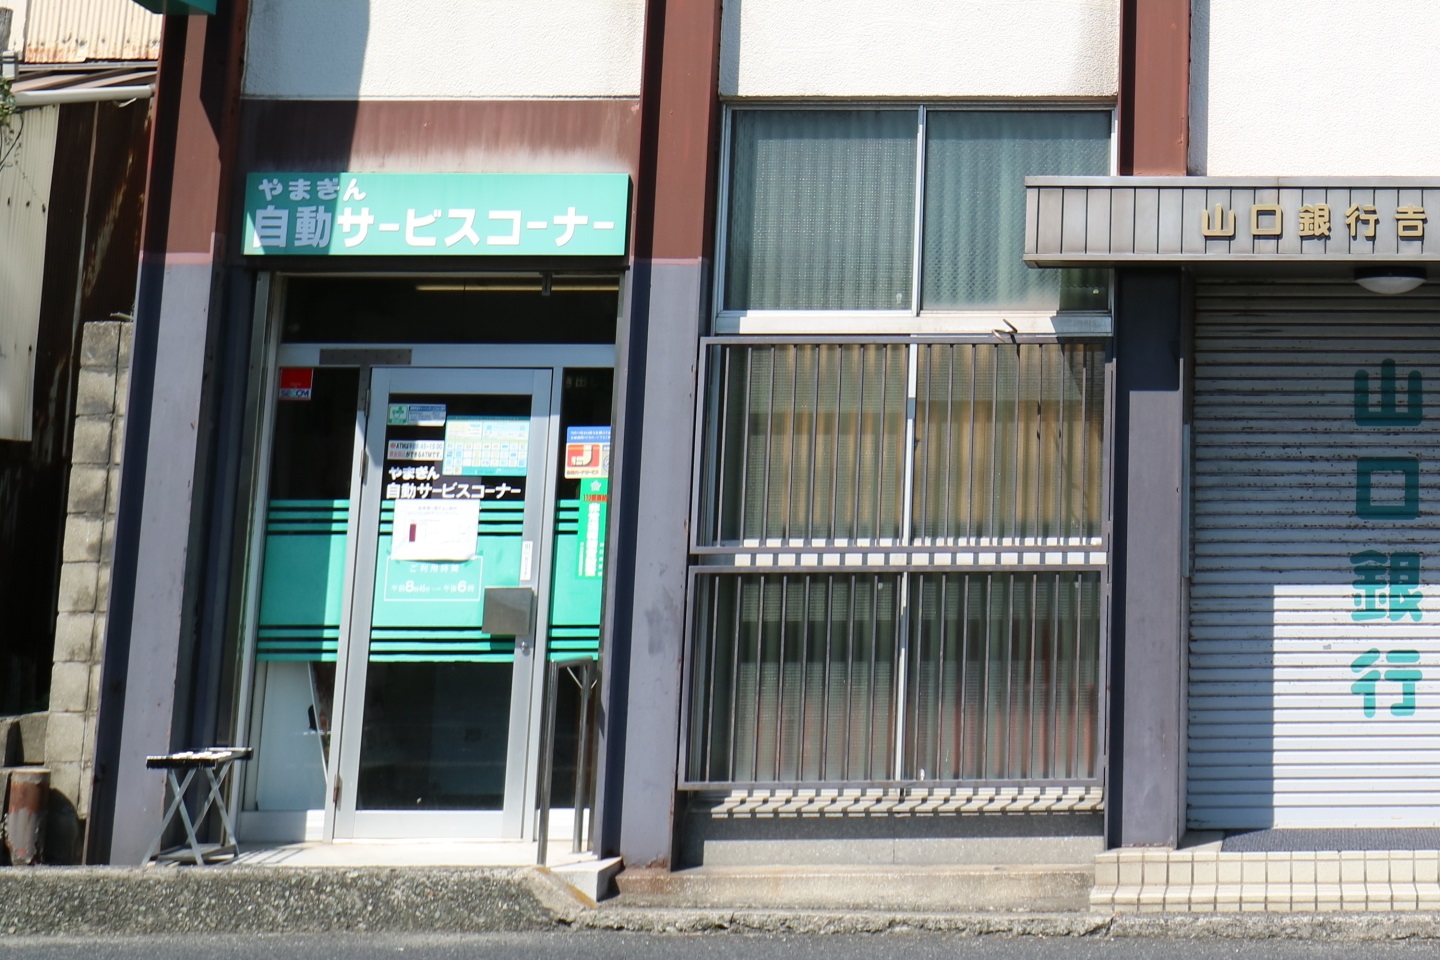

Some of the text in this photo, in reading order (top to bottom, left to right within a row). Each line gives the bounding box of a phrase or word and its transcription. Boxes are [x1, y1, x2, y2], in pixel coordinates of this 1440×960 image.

[258, 178, 367, 201] やまぎん
[252, 205, 615, 248] 自動サービスコーナー
[389, 466, 440, 480] やまぎん
[386, 482, 521, 499] 自動サービスコーナー
[1351, 358, 1424, 717] 山口銀行
